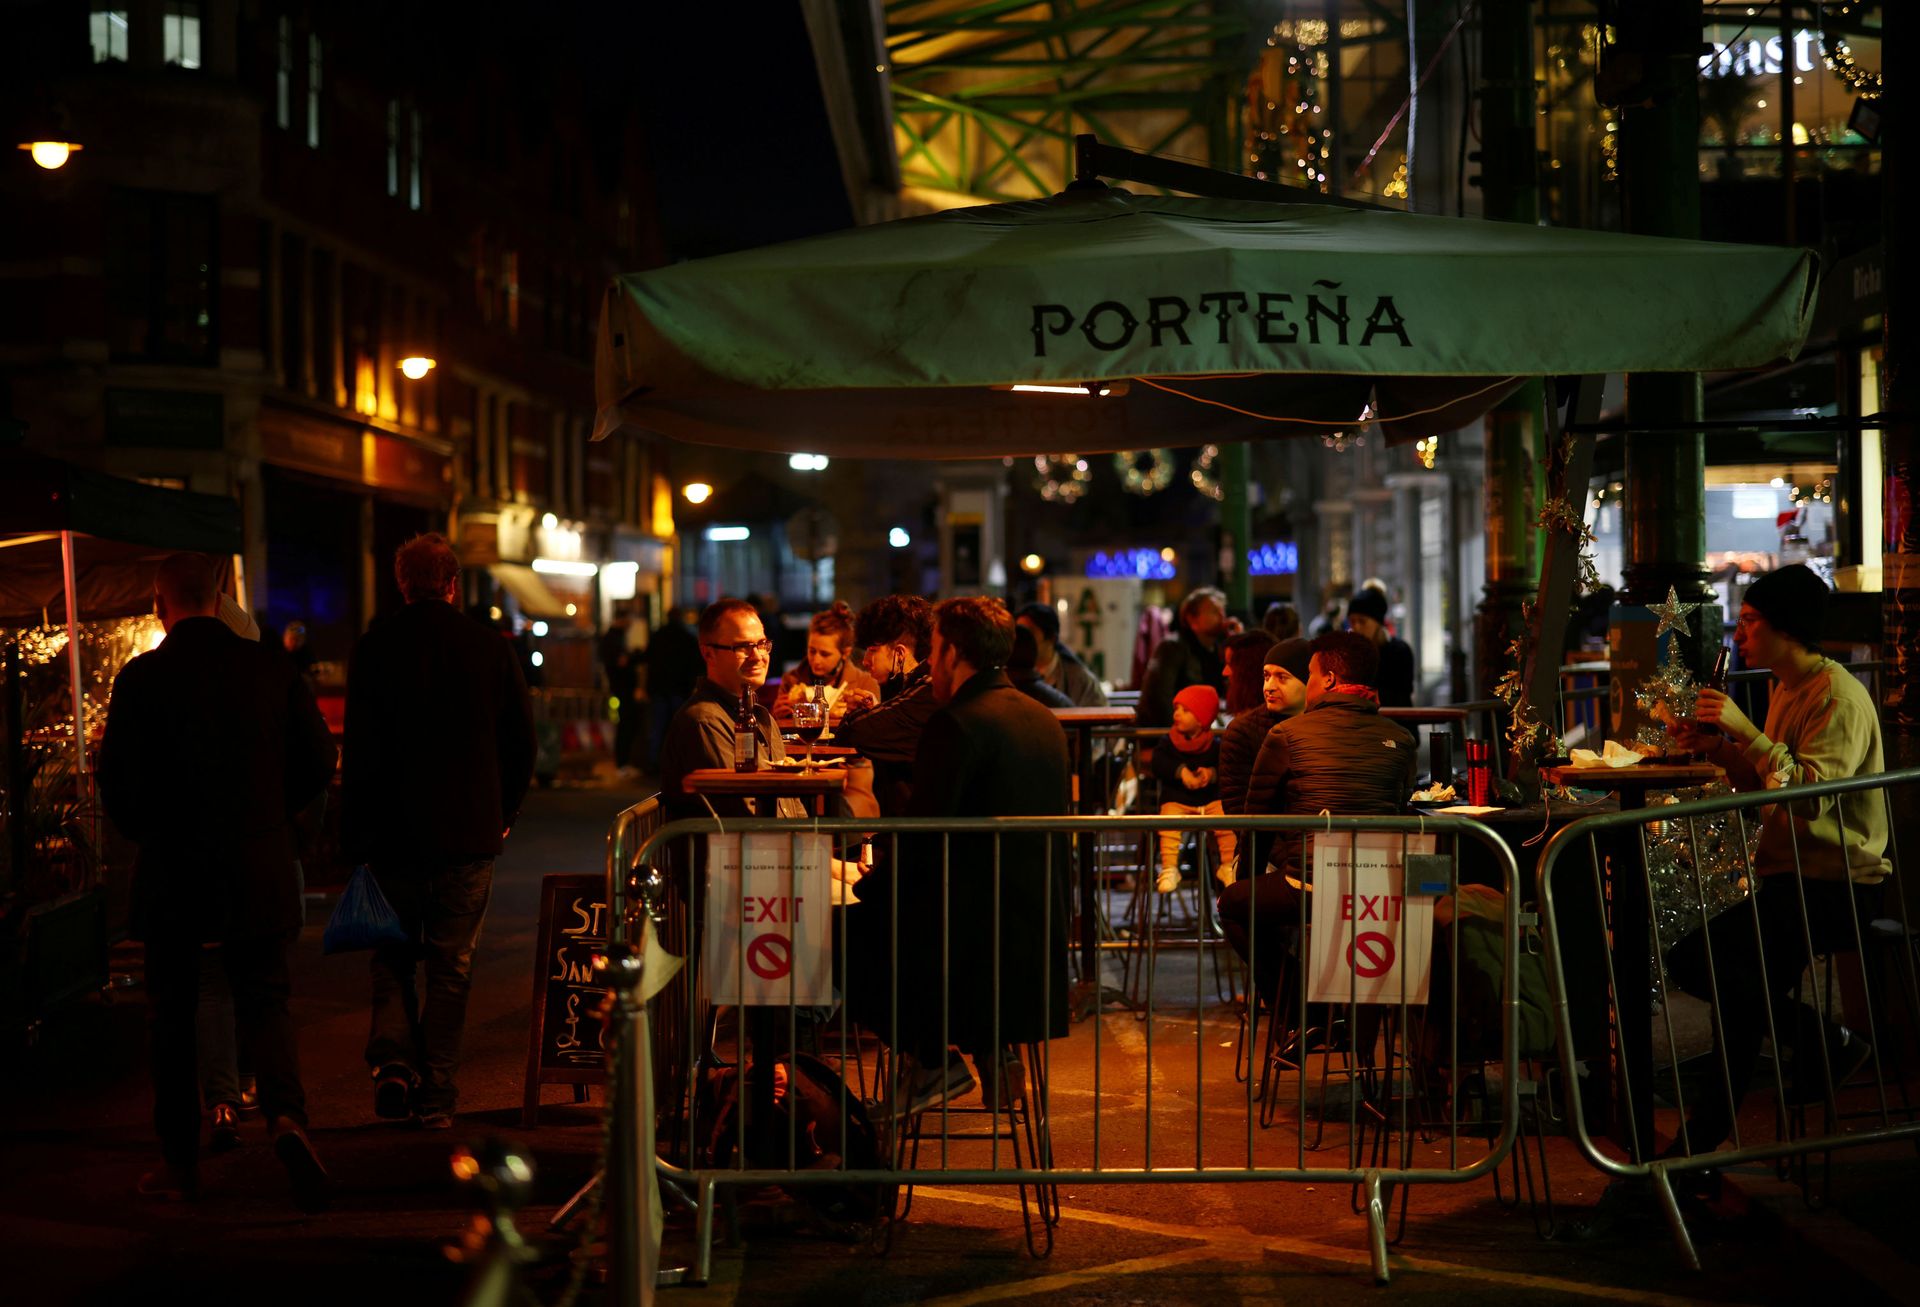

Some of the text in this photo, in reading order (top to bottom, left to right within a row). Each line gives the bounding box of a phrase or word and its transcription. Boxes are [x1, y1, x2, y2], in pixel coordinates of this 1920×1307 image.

[1031, 279, 1413, 357] PORTEÑA
[743, 897, 804, 923] EXIT
[1342, 895, 1402, 921] EXIT
